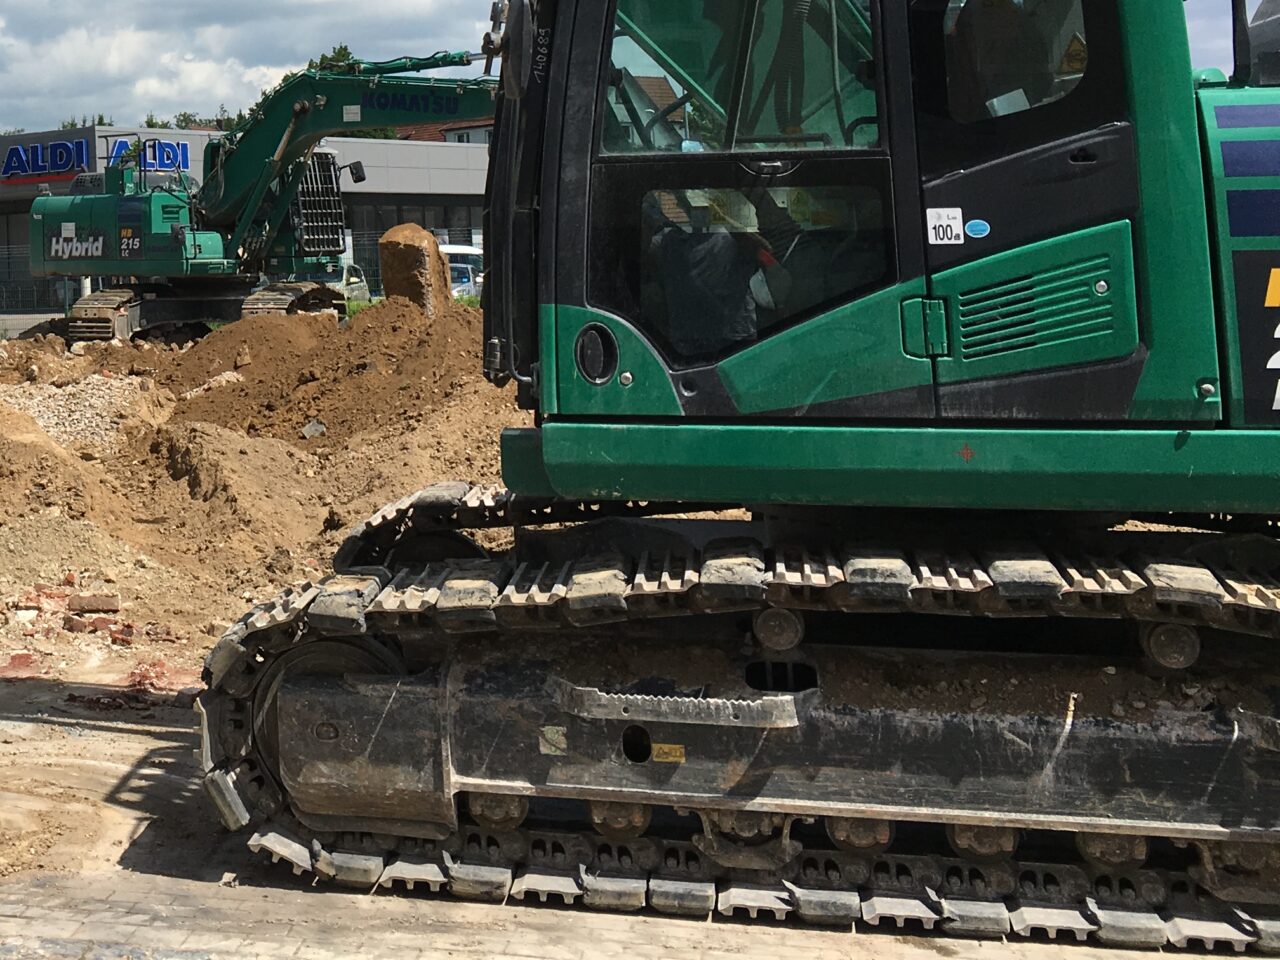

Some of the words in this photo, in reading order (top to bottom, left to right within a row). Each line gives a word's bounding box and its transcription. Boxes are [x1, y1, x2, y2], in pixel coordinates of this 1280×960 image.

[362, 90, 460, 115] KOMATSU
[0, 139, 89, 177] ALDI
[121, 228, 133, 238] HB
[932, 224, 953, 241] 100
[50, 236, 103, 259] Hybrid
[121, 238, 140, 249] 215
